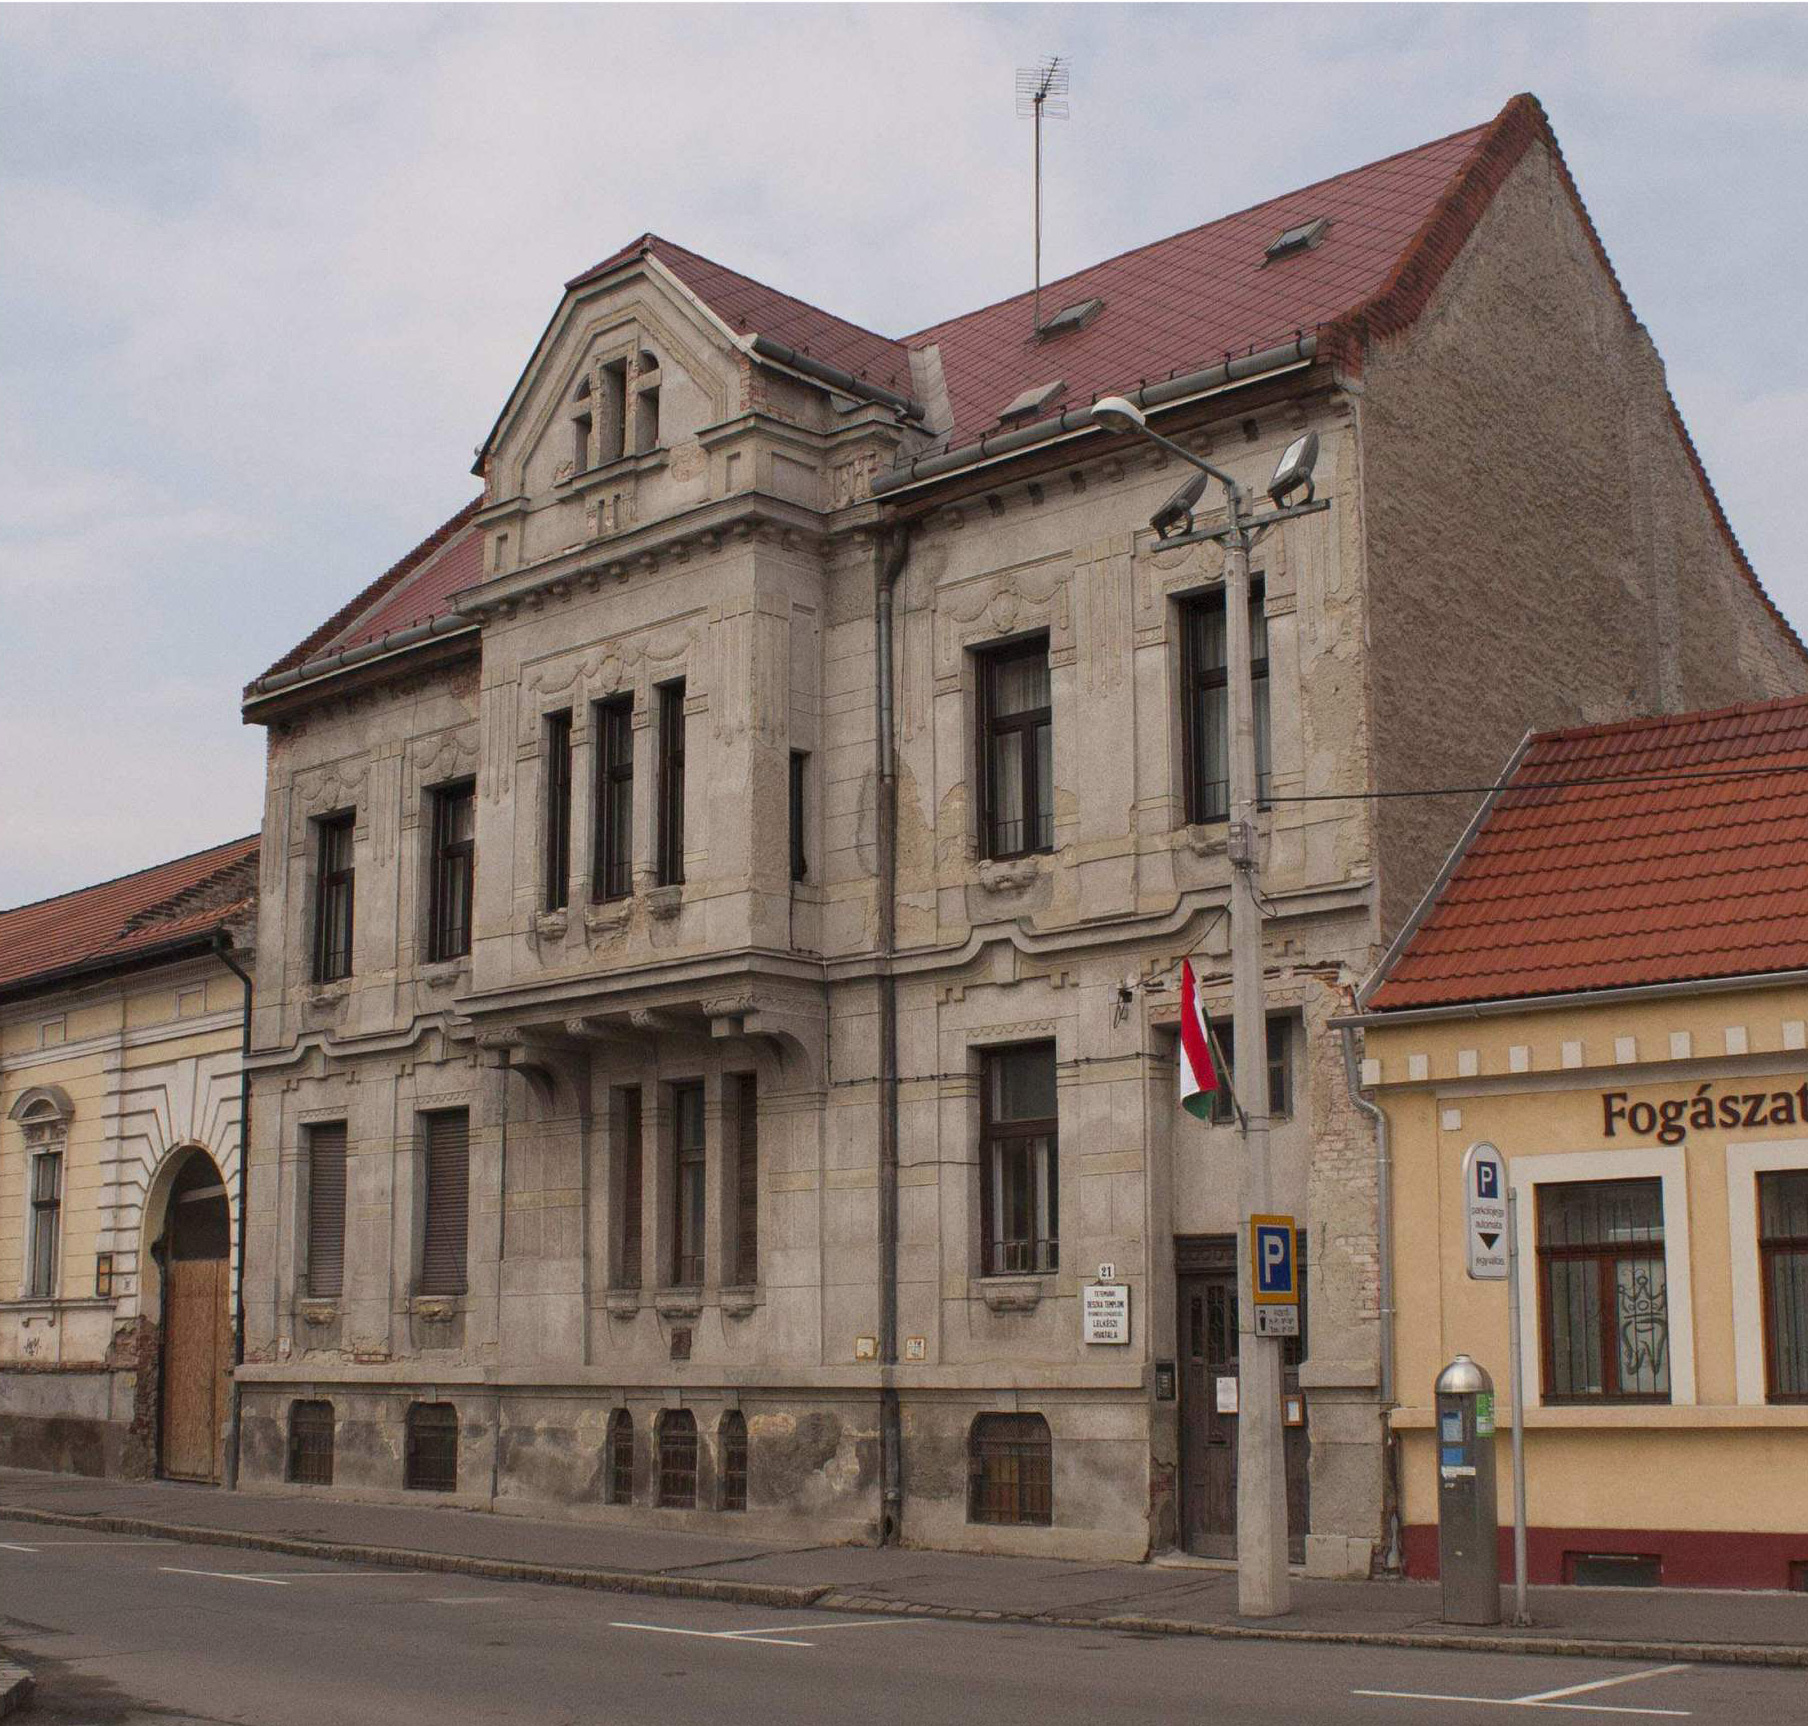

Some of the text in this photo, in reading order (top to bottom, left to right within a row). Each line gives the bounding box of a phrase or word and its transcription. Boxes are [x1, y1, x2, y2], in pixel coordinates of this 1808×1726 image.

[1481, 1166, 1493, 1194] P
[1263, 1235, 1285, 1283] P
[1101, 1266, 1112, 1277] 21
[1092, 1317, 1118, 1328] LELKÉSZI
[1093, 1330, 1118, 1339] HIVATALA
